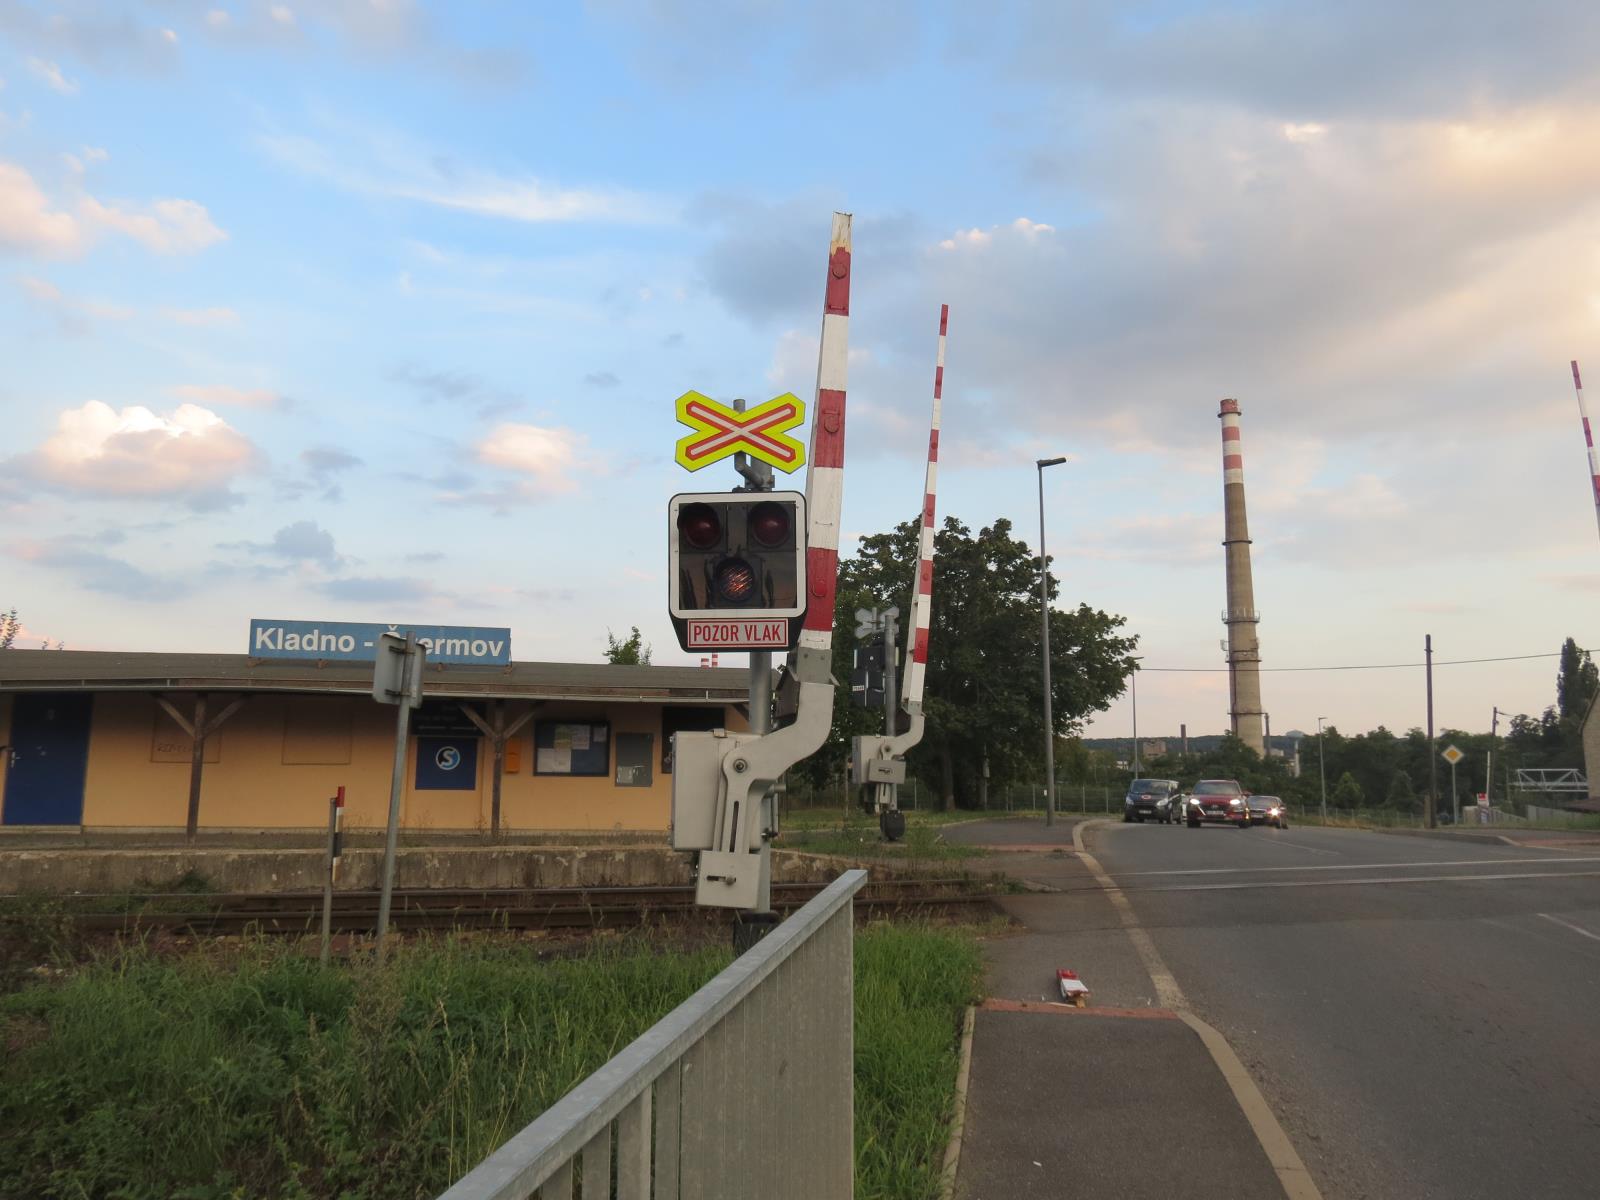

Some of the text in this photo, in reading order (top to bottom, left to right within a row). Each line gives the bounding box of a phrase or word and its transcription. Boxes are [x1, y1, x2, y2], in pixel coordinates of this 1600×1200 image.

[255, 627, 356, 653] Kladno
[385, 624, 504, 657] ermov
[693, 624, 781, 642] POZOR VLAK
